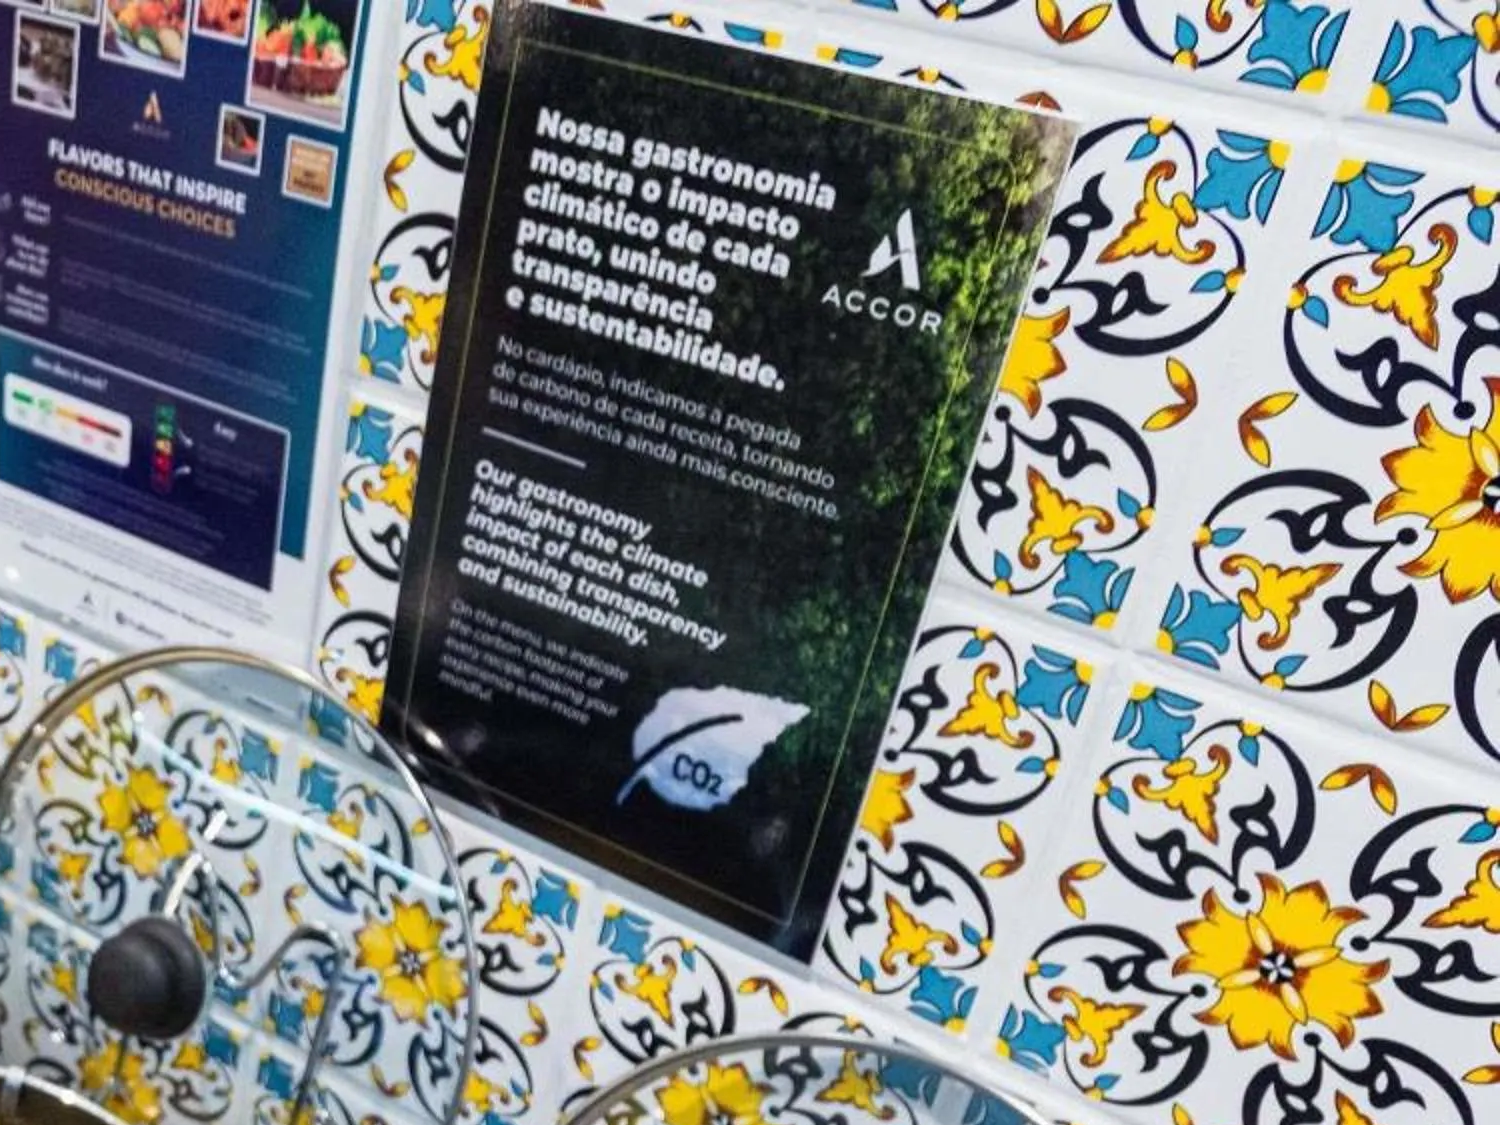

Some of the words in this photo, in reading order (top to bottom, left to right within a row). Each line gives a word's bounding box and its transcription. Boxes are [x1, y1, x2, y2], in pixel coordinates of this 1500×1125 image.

[48, 137, 125, 179] FLAVORS
[128, 159, 175, 191] THAT
[174, 174, 247, 215] INSPIRE
[54, 168, 155, 214] CONSCIOUS
[158, 199, 237, 239] CHOICES
[530, 148, 634, 197] mostra
[641, 179, 662, 203] o
[667, 176, 801, 241] impacto
[536, 106, 626, 156] Nossa
[631, 137, 837, 211] gastronomia
[516, 217, 602, 267] prato,
[609, 244, 717, 294] unindo
[523, 181, 659, 241] climático
[666, 220, 706, 254] de
[712, 237, 791, 278] cada
[511, 249, 714, 333] transparência
[821, 284, 942, 335] ACCOR
[505, 286, 525, 309] e
[529, 293, 786, 392] sustentabilidade.
[488, 388, 519, 410] sua
[521, 398, 622, 445] experiência
[624, 431, 678, 464] ainda
[680, 453, 727, 482] mais
[492, 361, 516, 383] de
[519, 371, 591, 408] carbono
[593, 394, 618, 417] de
[620, 407, 666, 434] cada
[669, 422, 738, 459] receita,
[742, 444, 835, 489] tornando
[498, 335, 523, 359] No
[525, 346, 606, 389] cardápio,
[609, 370, 706, 419] indicamos
[709, 408, 721, 424] a
[725, 414, 802, 451] pegada
[470, 482, 577, 539] highlights
[580, 525, 618, 555] the
[621, 542, 708, 588] climate
[475, 459, 517, 489] Our
[518, 477, 653, 542] gastronomy
[458, 556, 501, 586] and
[502, 574, 649, 647] sustainability.
[461, 533, 574, 592] combining
[576, 576, 727, 652] transparency
[465, 506, 542, 550] impact
[543, 540, 570, 561] of
[569, 550, 625, 584] each
[627, 571, 681, 609] dish,
